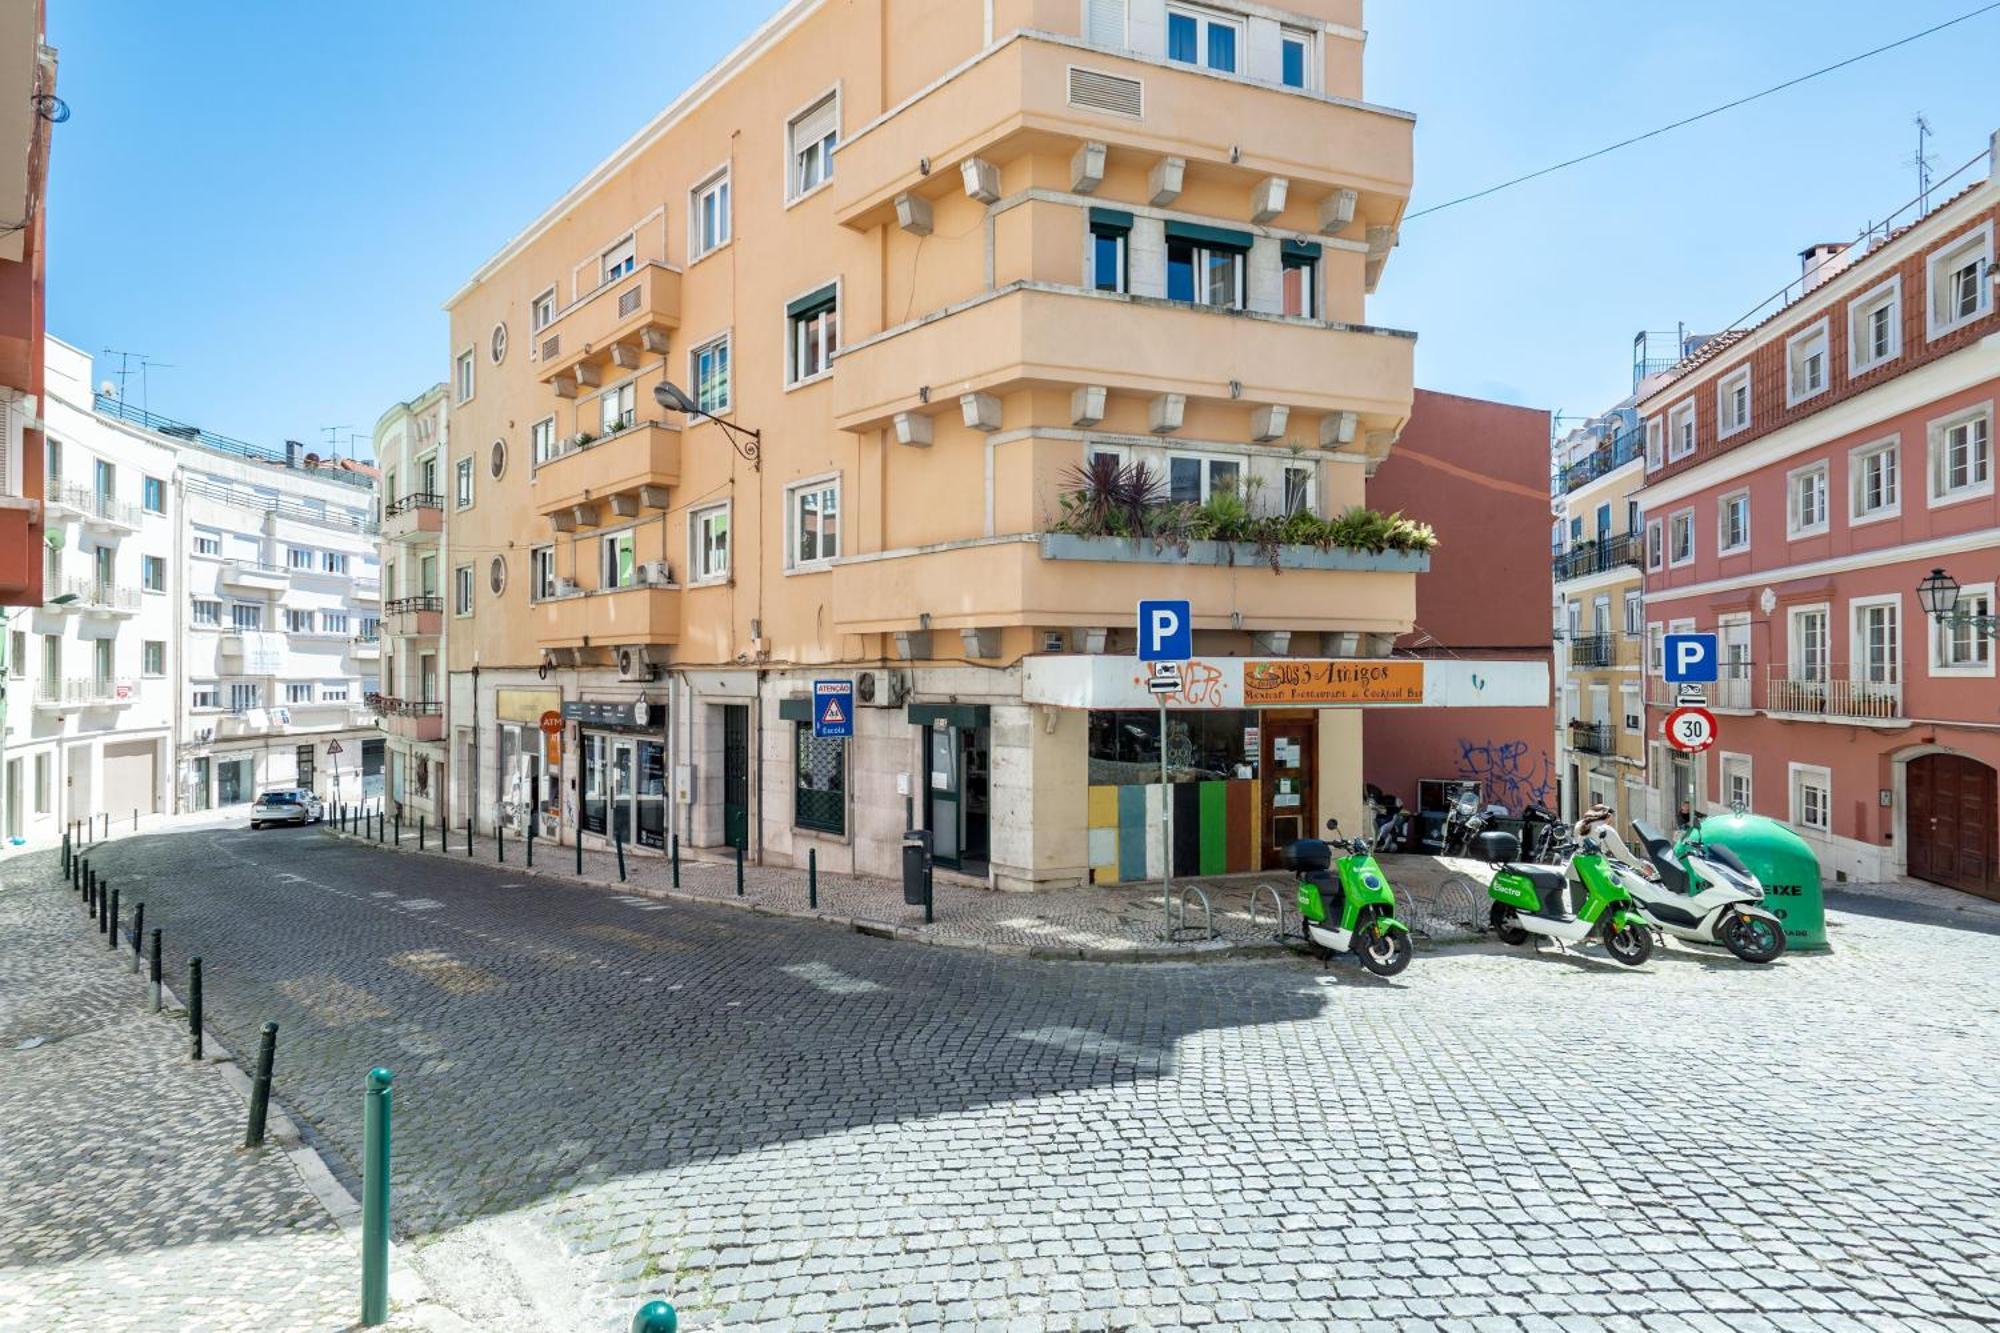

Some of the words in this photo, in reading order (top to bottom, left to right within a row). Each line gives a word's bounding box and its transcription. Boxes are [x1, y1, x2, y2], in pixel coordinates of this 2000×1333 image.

[1151, 610, 1179, 651] P
[1676, 641, 1704, 675] P
[1301, 663, 1312, 684] 3
[1313, 662, 1389, 688] Amigos
[1407, 688, 1423, 698] Bar
[543, 718, 562, 726] ATM
[1682, 720, 1702, 738] 30
[1762, 884, 1802, 896] EIXE
